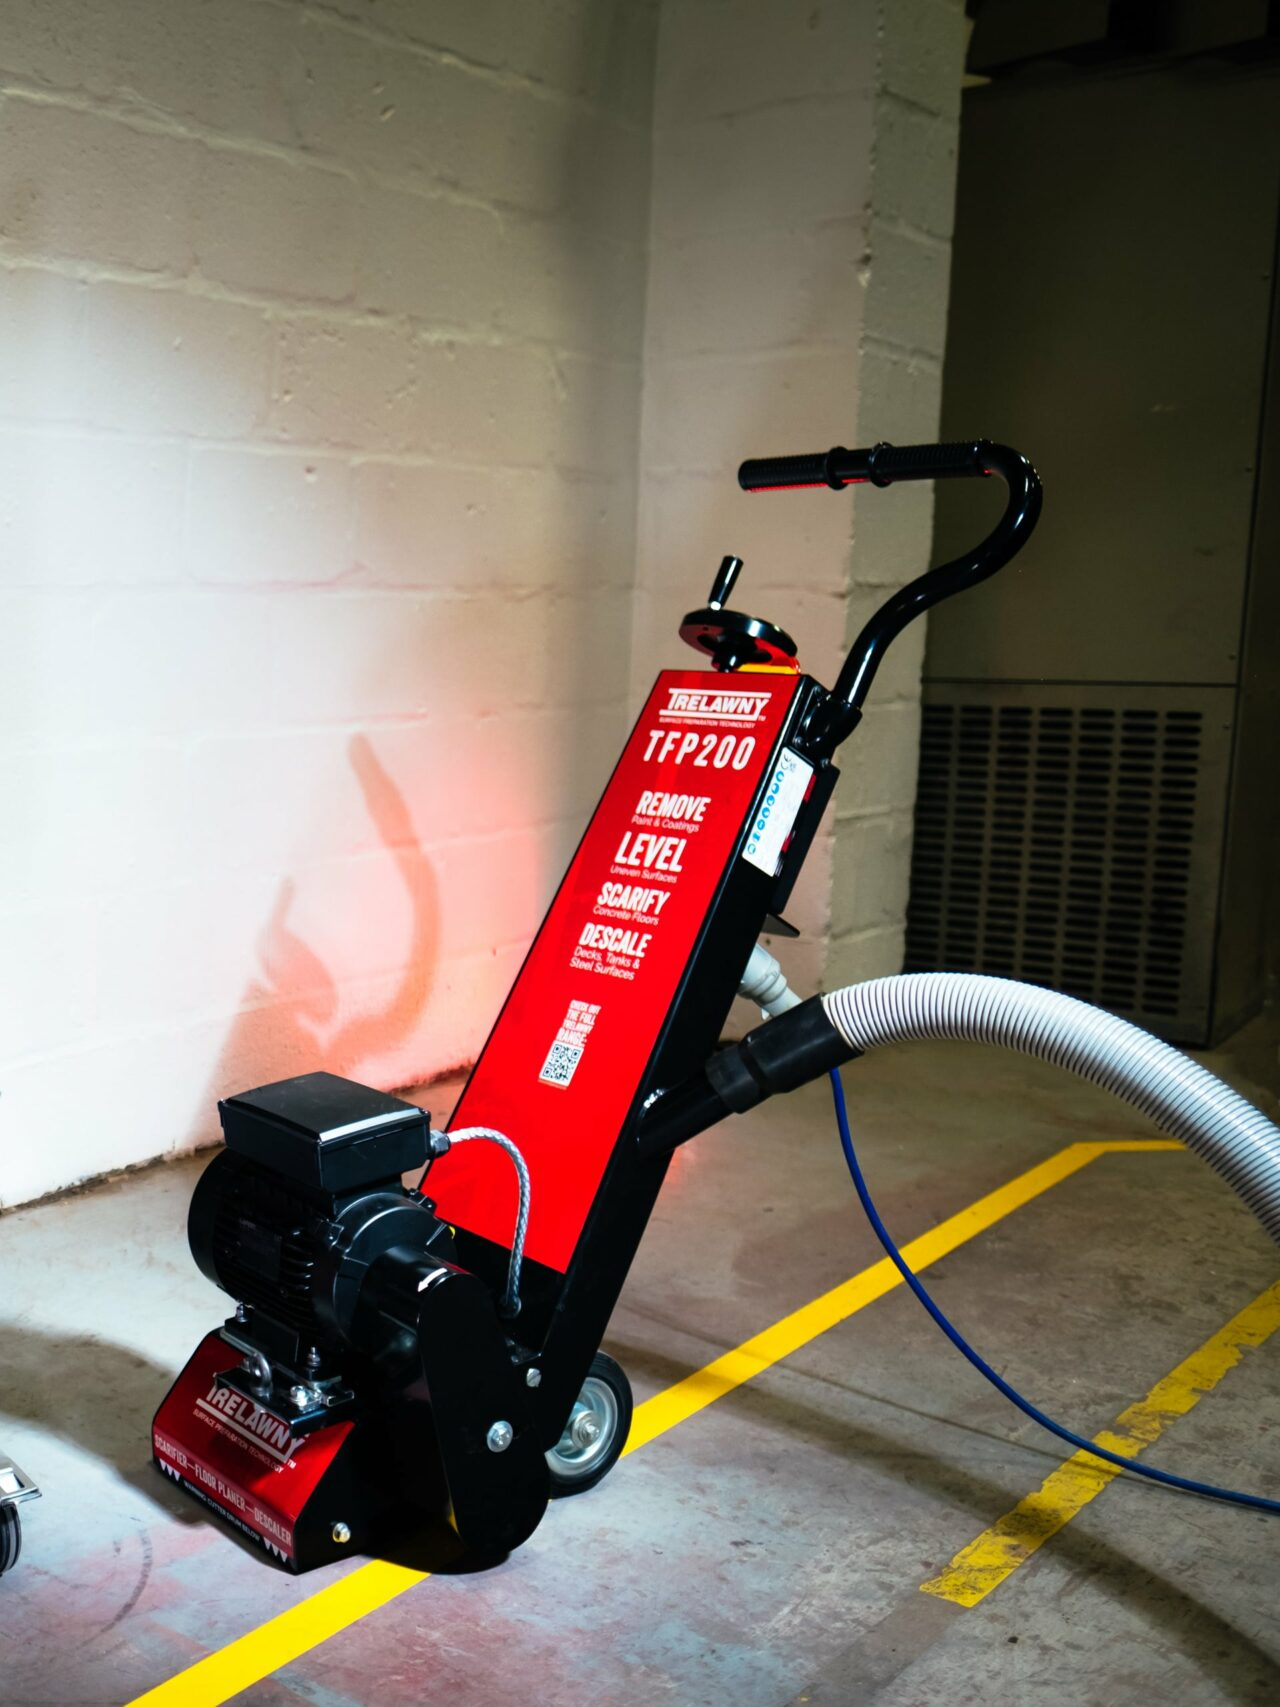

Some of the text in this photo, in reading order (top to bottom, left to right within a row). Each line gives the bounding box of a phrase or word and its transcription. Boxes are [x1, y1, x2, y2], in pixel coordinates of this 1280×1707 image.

[660, 688, 772, 721] TRELAWNY
[643, 730, 756, 770] TFP200
[636, 790, 712, 822] REMOVE
[631, 815, 700, 834] Paint & Coatings
[614, 831, 687, 873] LEVEL
[611, 866, 677, 883] Uneven Surfaces
[597, 881, 671, 915] SCARIFY
[593, 905, 659, 926] Concrete Floors
[579, 922, 652, 958] DESCALE
[570, 957, 635, 981] Steel Surfaces
[574, 946, 640, 969] Decks, Tanks &
